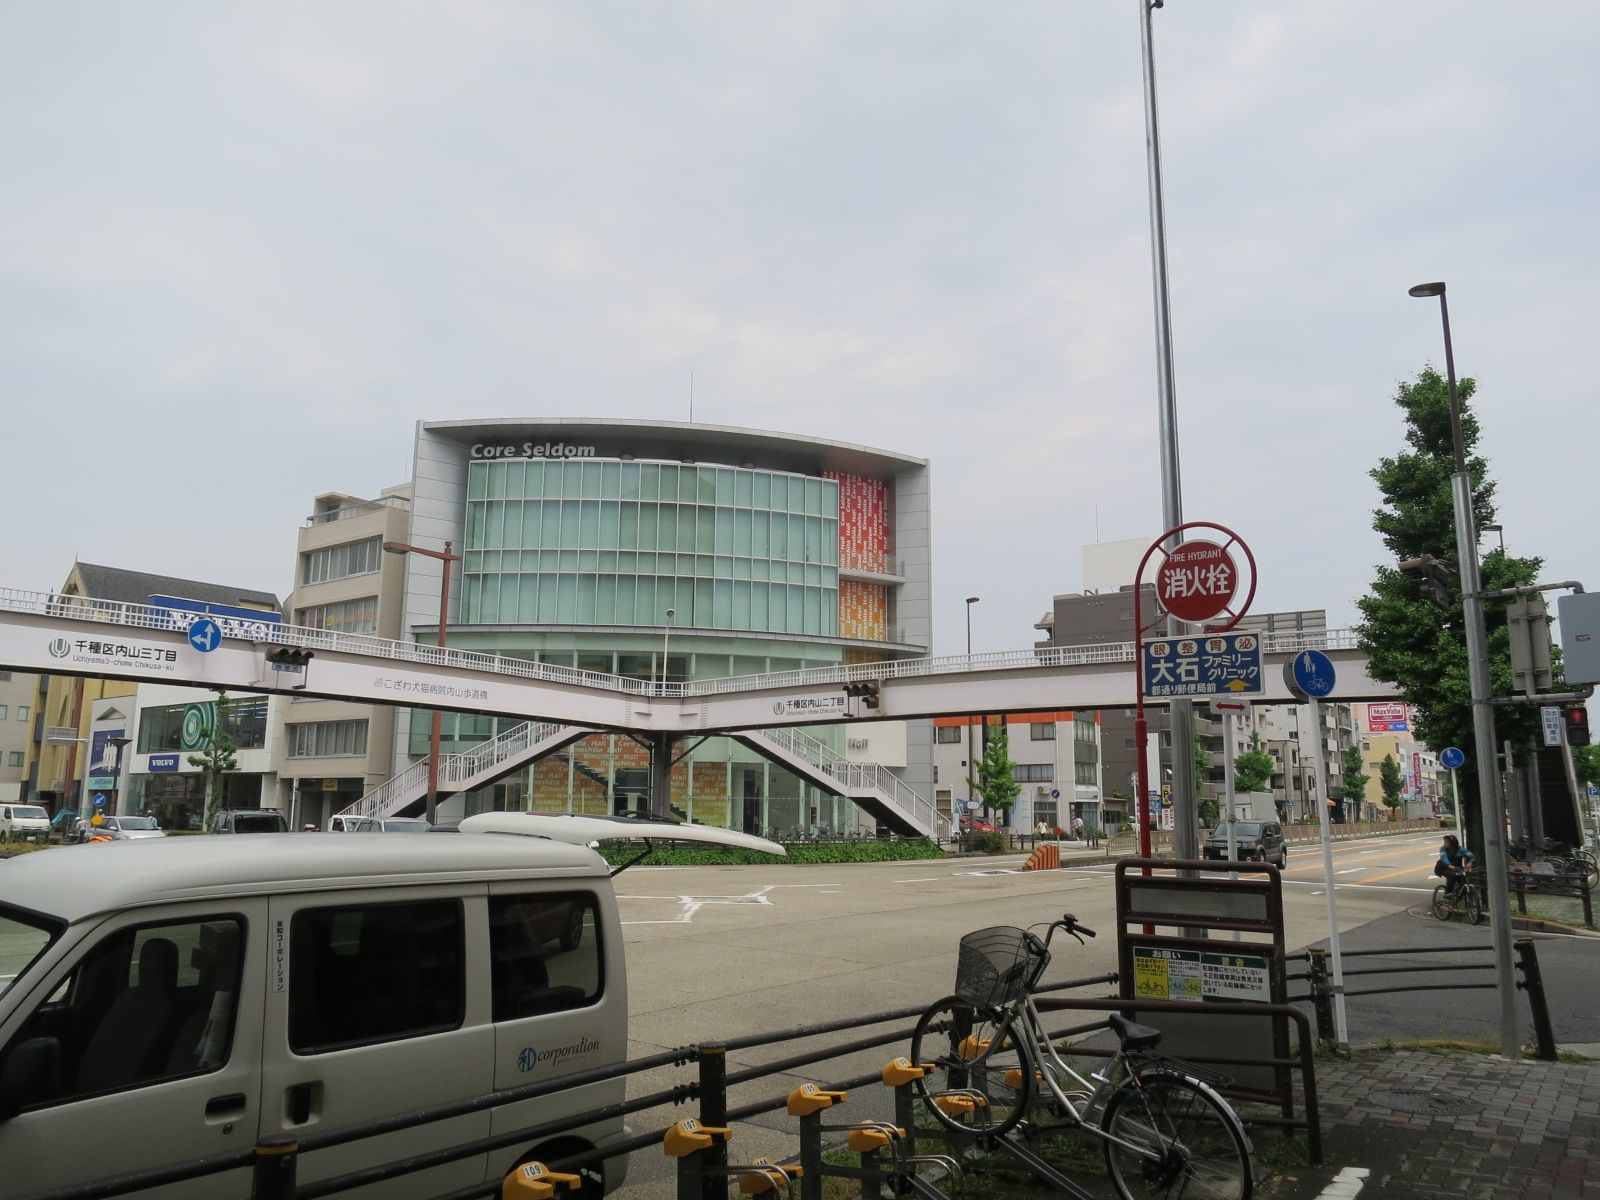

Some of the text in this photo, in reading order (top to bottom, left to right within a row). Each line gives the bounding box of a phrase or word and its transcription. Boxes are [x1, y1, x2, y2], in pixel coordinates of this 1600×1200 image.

[470, 442, 596, 458] Core Seldom
[1169, 549, 1222, 563] FIRE HYDRANT
[1164, 563, 1231, 599] 消火栓
[75, 639, 178, 662] 千種区内山三丁目
[1153, 638, 1253, 656] 眼 整 胃 泌
[134, 661, 175, 672] Chikusa-ku
[1151, 653, 1252, 684] 大石 ファミリー
[1207, 666, 1258, 681] クリニック
[786, 696, 845, 710] 千種区内山二丁目
[537, 1036, 600, 1067] corporation
[684, 1120, 696, 1130] 107
[525, 1165, 541, 1177] 109
